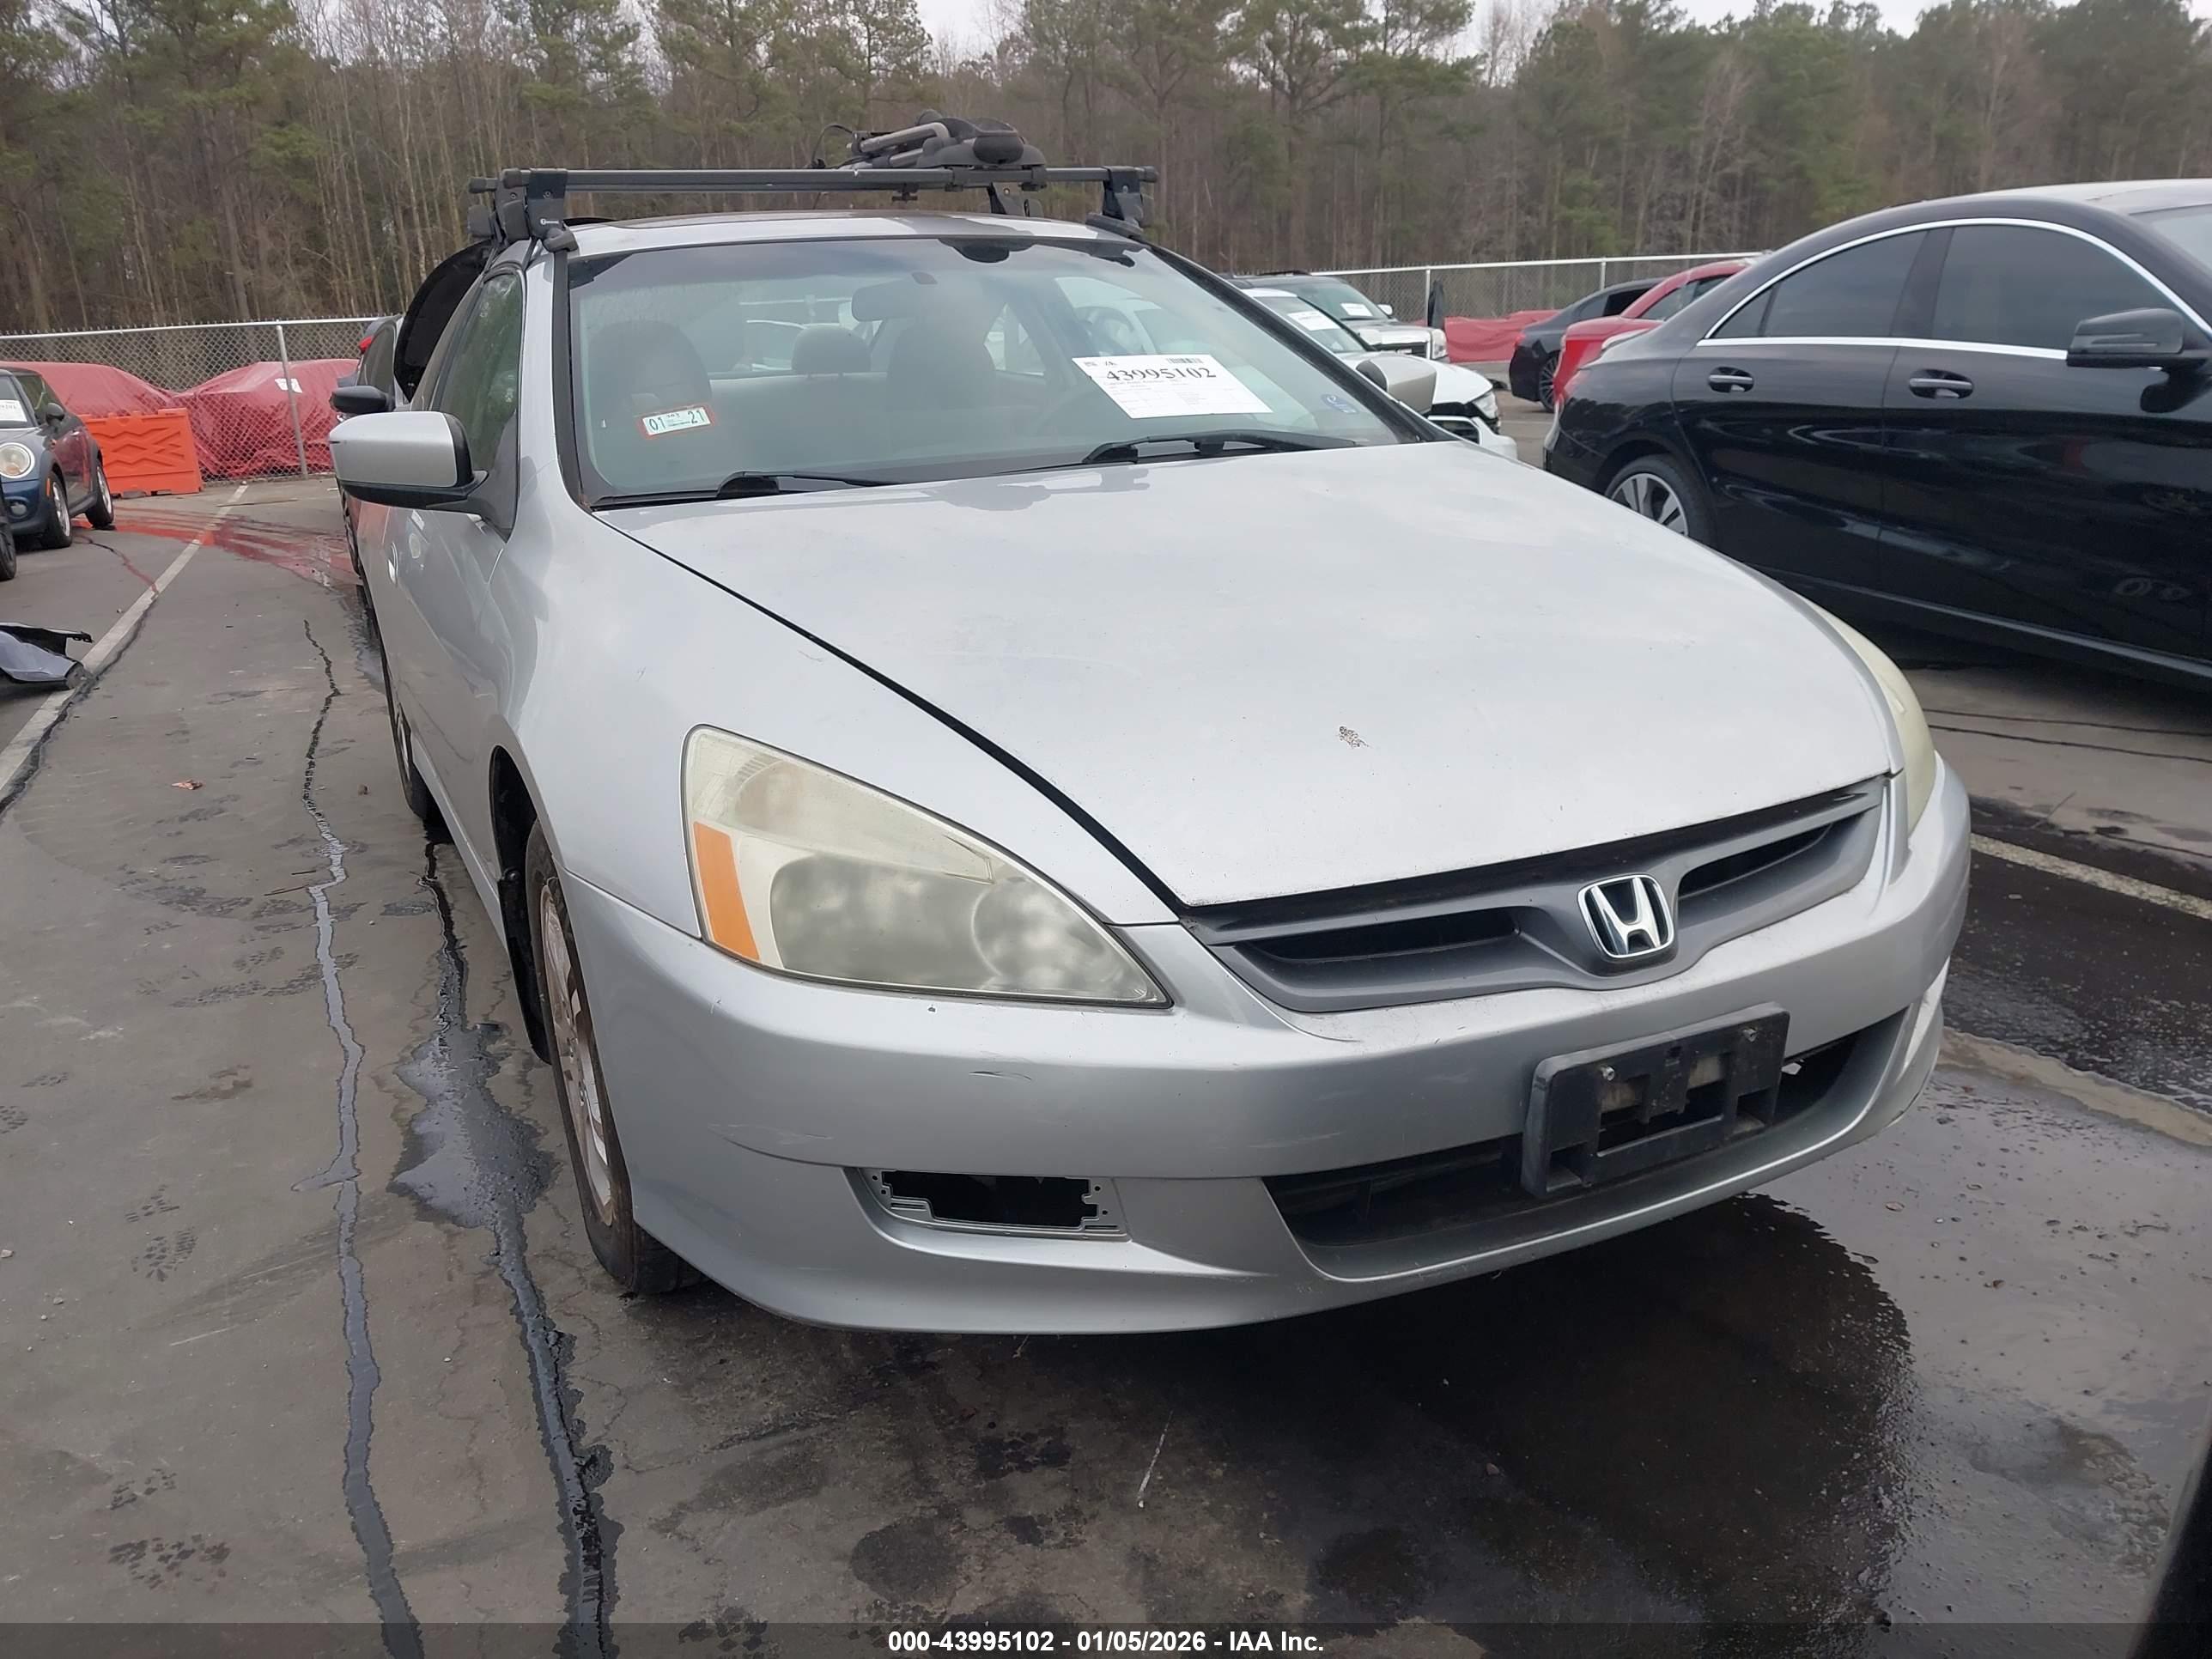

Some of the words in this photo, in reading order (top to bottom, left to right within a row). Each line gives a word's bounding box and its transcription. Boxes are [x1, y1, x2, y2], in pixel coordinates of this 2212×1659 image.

[1107, 368, 1217, 380] 43995102
[649, 417, 665, 431] 01
[688, 410, 705, 423] 21
